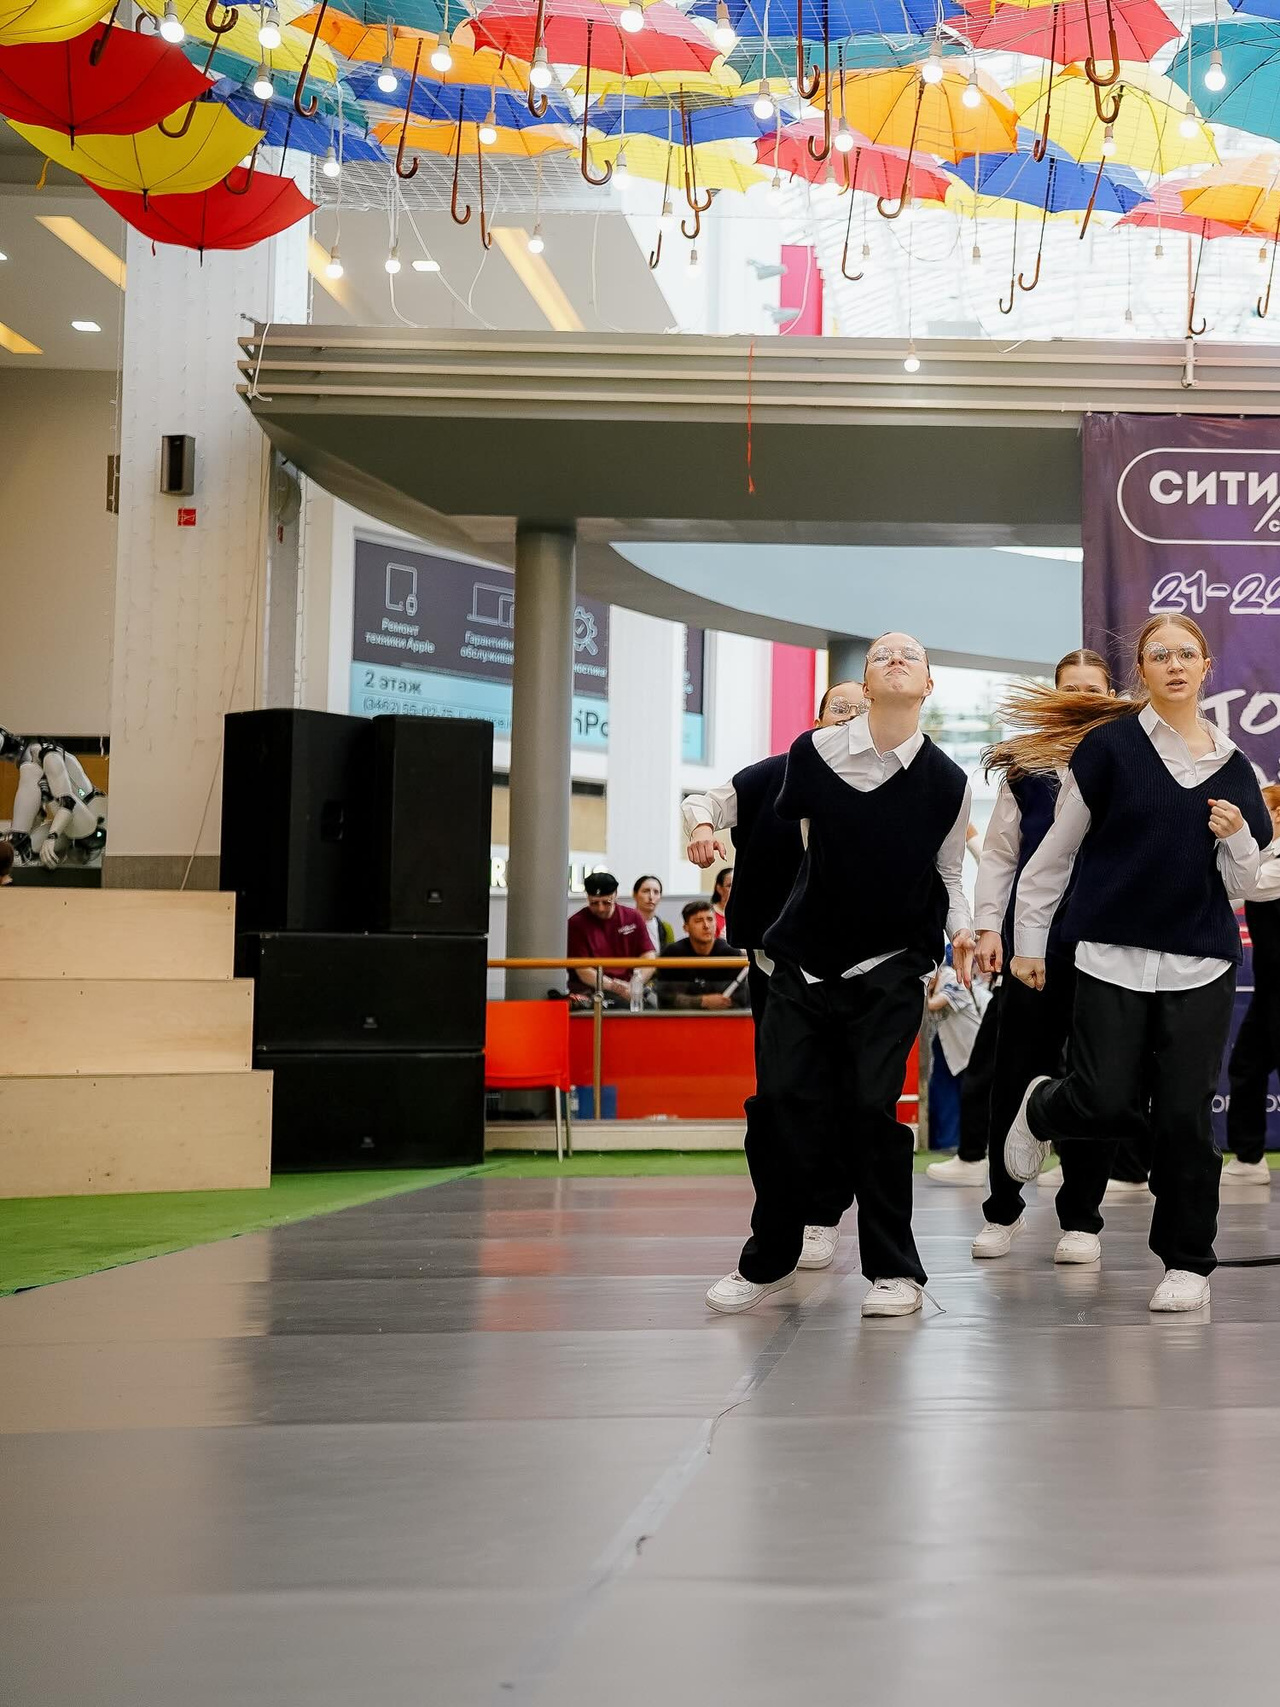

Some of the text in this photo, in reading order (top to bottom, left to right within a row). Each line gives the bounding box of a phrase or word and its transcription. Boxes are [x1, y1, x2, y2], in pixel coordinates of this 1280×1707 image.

[1148, 469, 1279, 506] СИТИ
[381, 617, 420, 636] Ремонт
[406, 636, 436, 654] Apple
[364, 671, 422, 695] 2 этаж
